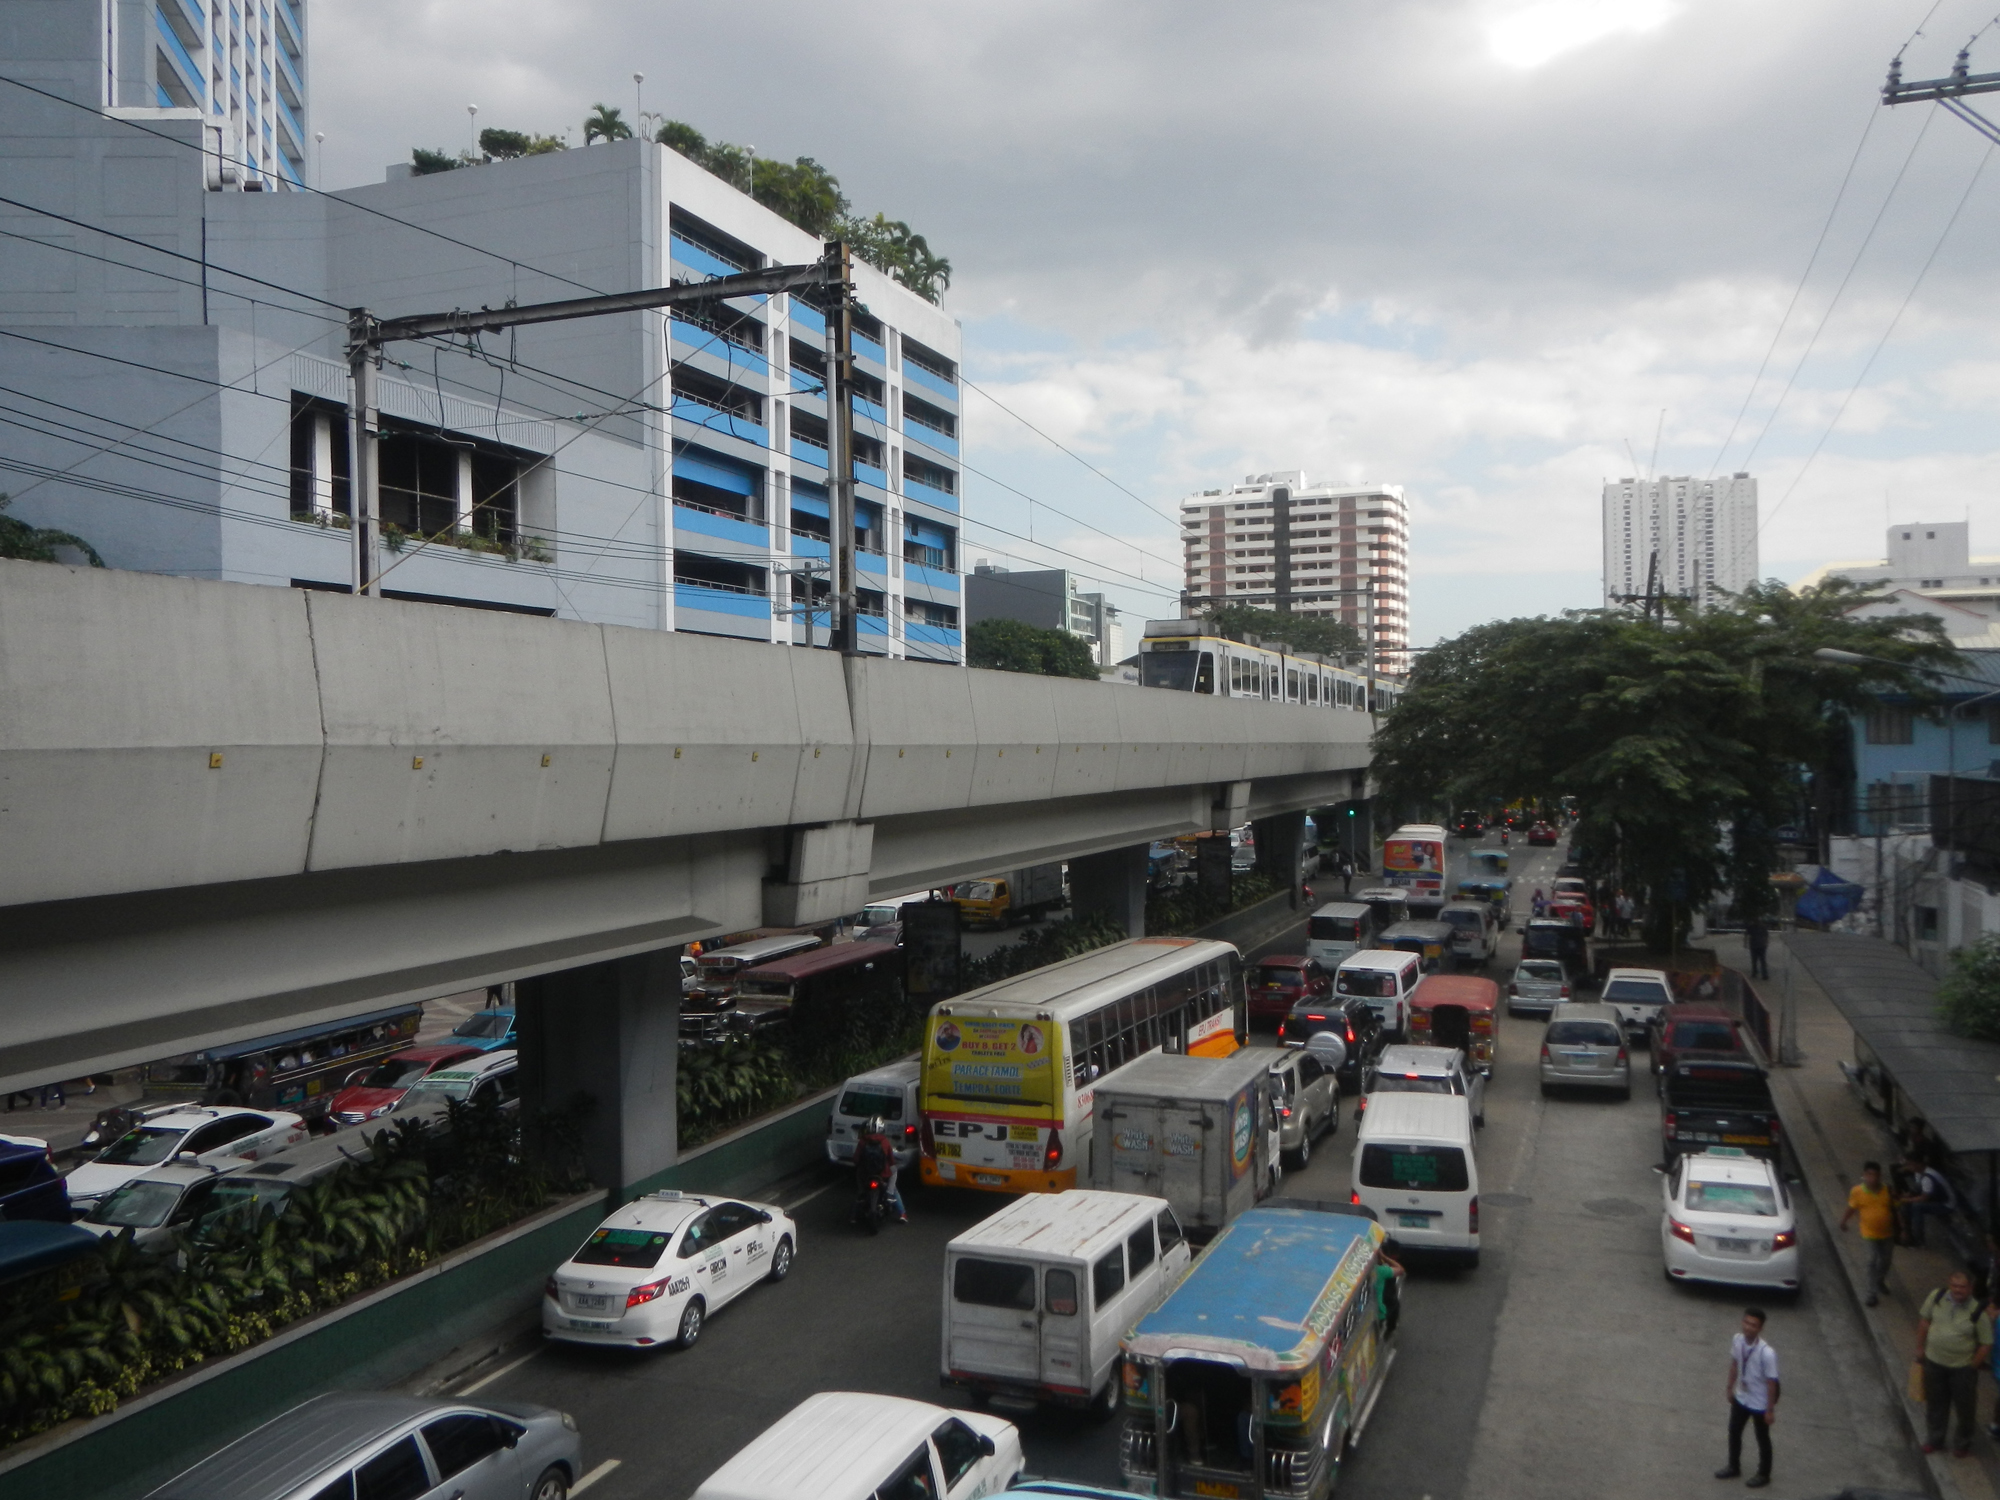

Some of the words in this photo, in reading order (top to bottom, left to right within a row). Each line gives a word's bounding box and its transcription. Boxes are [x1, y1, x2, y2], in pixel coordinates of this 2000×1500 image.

[1198, 1023, 1206, 1036] EPJ
[962, 1041, 980, 1049] BUY
[992, 1042, 1008, 1050] GET
[1010, 1042, 1016, 1051] 2
[954, 1064, 1020, 1077] PARACETAMOL
[954, 1081, 991, 1094] TEMPRA
[994, 1084, 1021, 1096] FORTE
[934, 1120, 1008, 1141] EPJ
[1122, 1127, 1149, 1140] White
[1123, 1138, 1148, 1150] WASH
[1169, 1132, 1194, 1145] White
[1169, 1143, 1194, 1155] WASH
[709, 1257, 727, 1275] AIRCON
[668, 1276, 691, 1297] AAA1269
